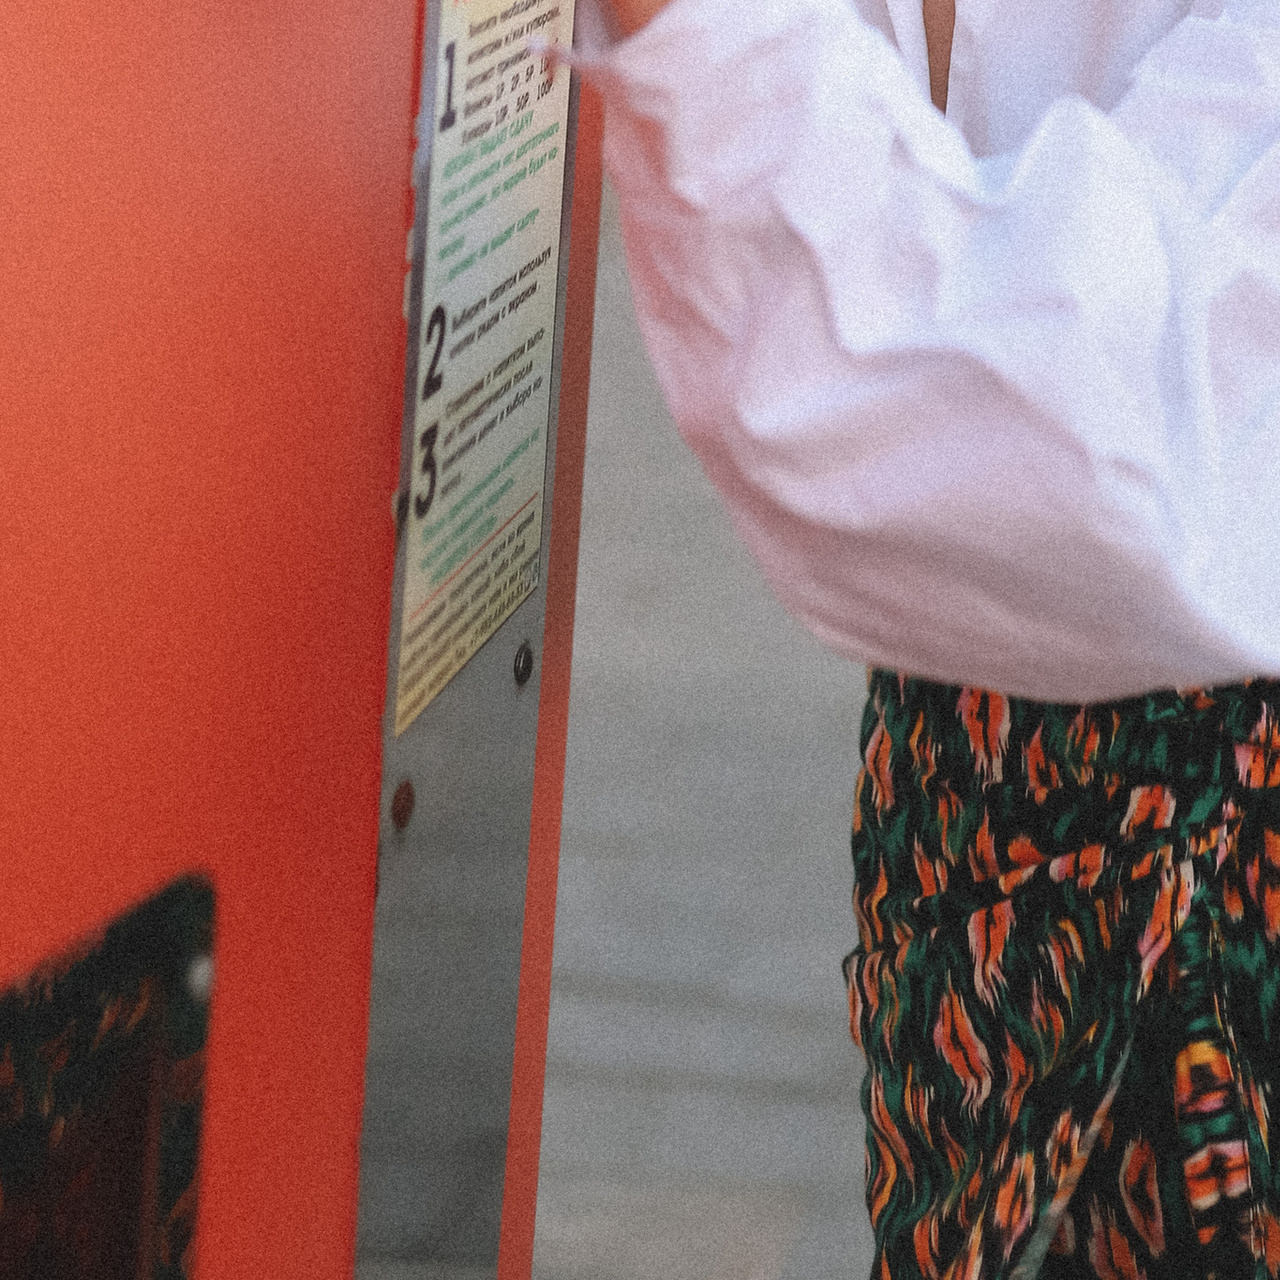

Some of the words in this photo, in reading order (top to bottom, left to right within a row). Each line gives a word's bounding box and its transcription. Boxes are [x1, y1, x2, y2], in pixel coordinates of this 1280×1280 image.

[439, 41, 457, 133] 1
[422, 304, 446, 402] 2
[414, 421, 438, 521] 3
